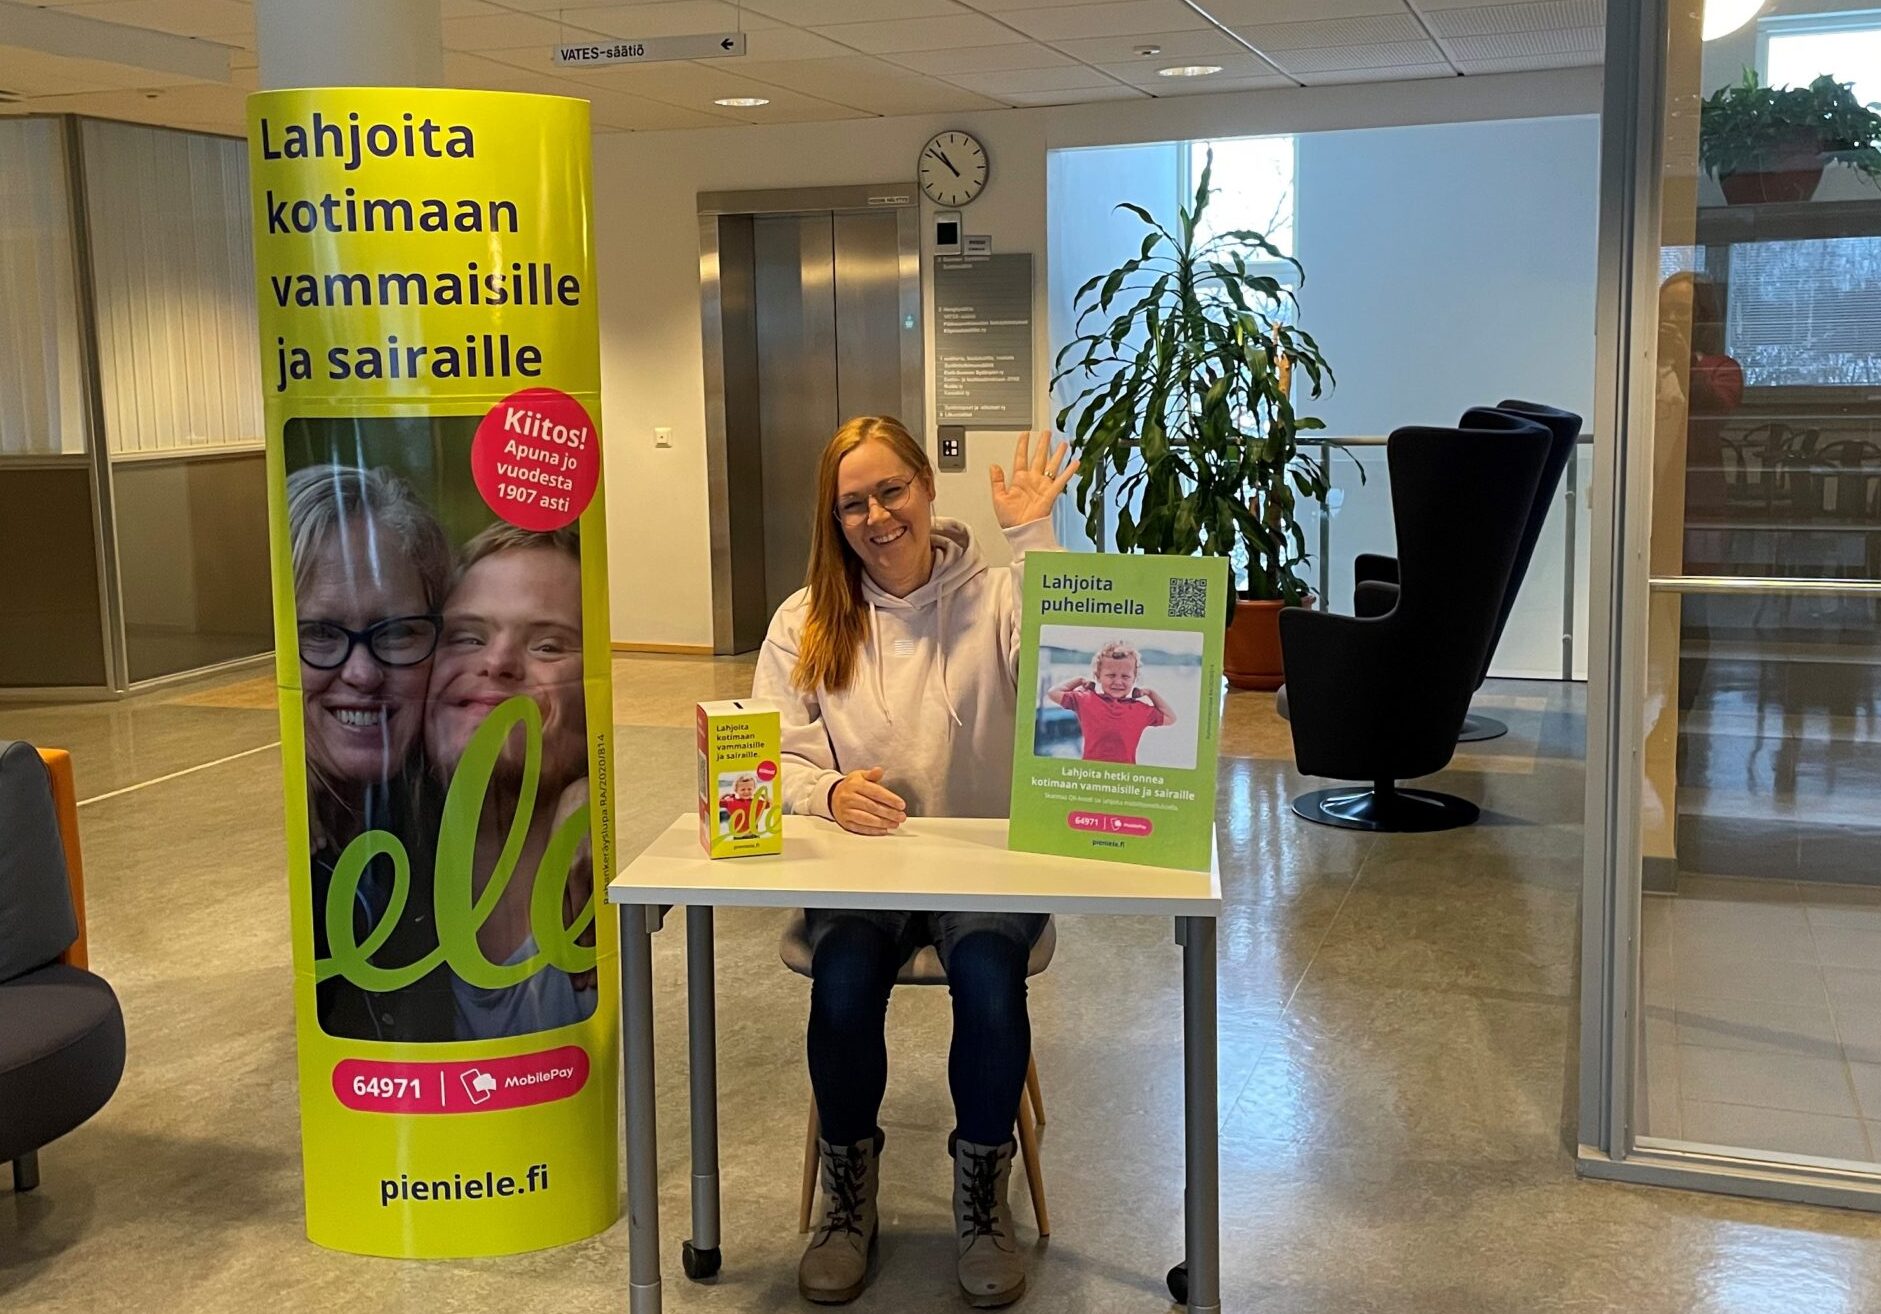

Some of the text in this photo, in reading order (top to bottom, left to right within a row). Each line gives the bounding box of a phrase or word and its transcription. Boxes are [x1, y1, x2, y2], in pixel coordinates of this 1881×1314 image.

[561, 44, 644, 61] VATES-säätiö
[261, 112, 474, 171] Lahjoita
[266, 188, 518, 234] kotimaan
[271, 262, 580, 307] vammaisille
[277, 335, 542, 392] ja sairaille
[504, 407, 587, 450] Kiitos!
[504, 440, 577, 471] Apuna jo
[497, 462, 572, 491] vuodesta
[498, 483, 570, 512] 1907 asti
[1042, 574, 1113, 593] Lahjoita
[1041, 597, 1144, 616] puhelimella
[717, 724, 749, 732] Lahjoita
[716, 753, 724, 761] ja
[717, 742, 765, 750] vammaisille
[1031, 776, 1195, 801] kotimaan vammaisille ja sairaille
[1061, 767, 1164, 785] Lahjoita hetki onnea
[1074, 816, 1099, 826] 64971
[353, 1066, 574, 1099] 64971 MobilePay
[381, 1164, 548, 1206] pieniele.fi
